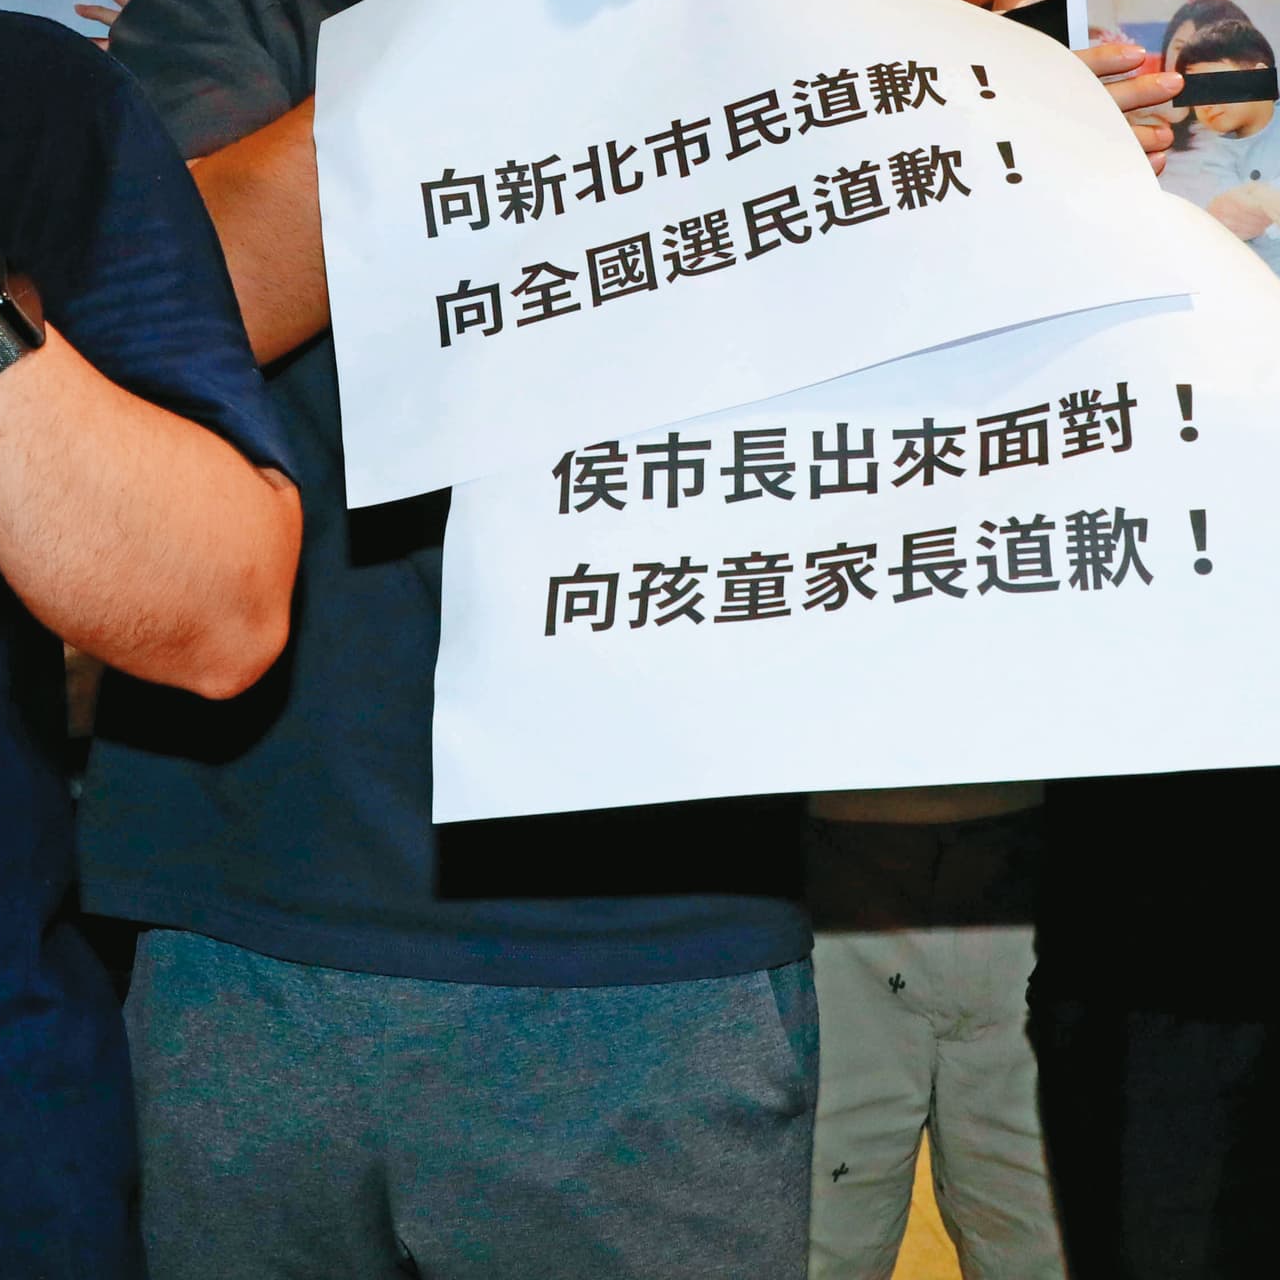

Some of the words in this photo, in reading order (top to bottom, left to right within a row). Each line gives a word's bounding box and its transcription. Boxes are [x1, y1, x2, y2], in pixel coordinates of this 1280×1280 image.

[420, 60, 996, 238] 向新北市民道歉！
[435, 141, 1023, 348] 向全國選民道歉！
[551, 381, 1199, 514] 侯市長出來面對！
[544, 506, 1213, 637] 向孩童家長道歉！
